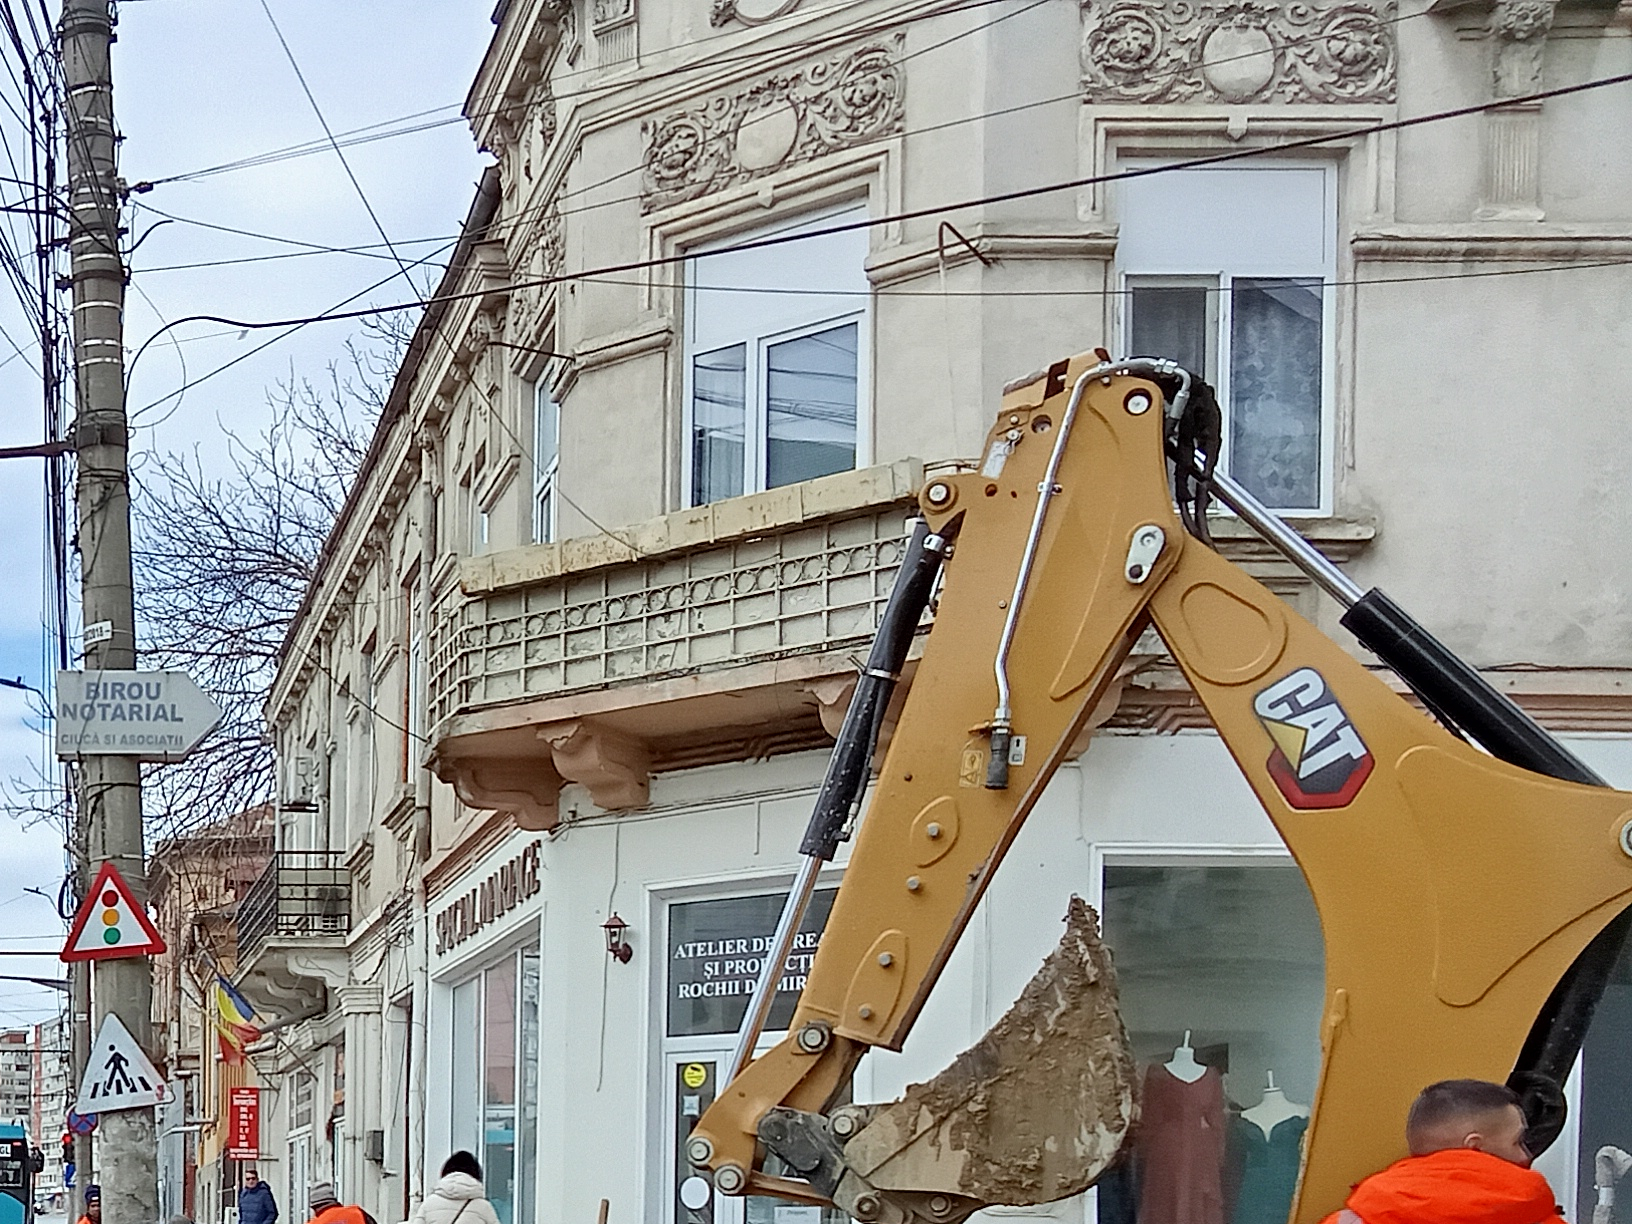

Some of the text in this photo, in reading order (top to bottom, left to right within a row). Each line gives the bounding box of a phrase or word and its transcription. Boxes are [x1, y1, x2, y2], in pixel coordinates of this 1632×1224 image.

[85, 682, 162, 700] BIROU
[61, 703, 184, 722] NOTARIAL
[1254, 666, 1368, 780] CAT
[674, 938, 748, 959] ATELIER
[678, 980, 740, 999] ROCHII
